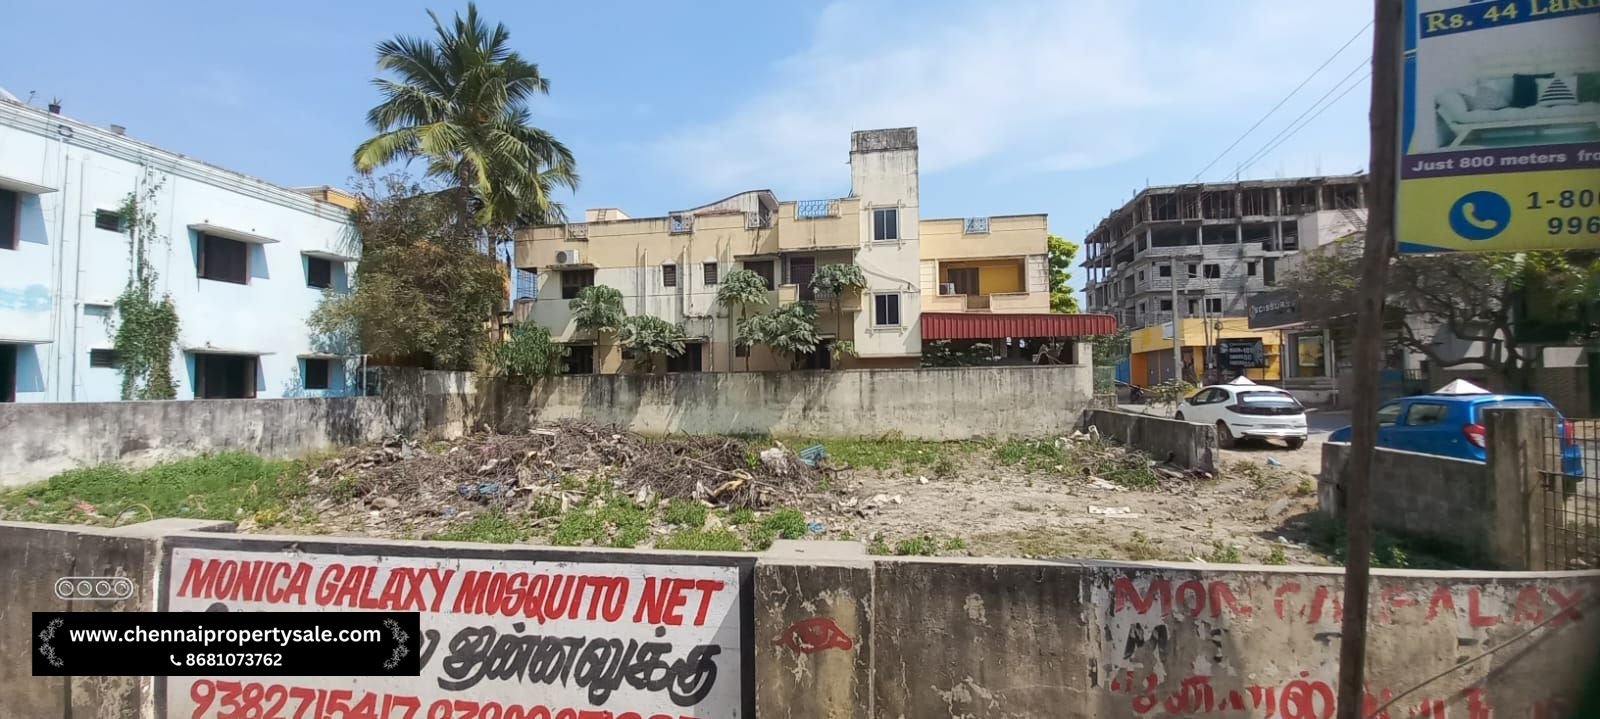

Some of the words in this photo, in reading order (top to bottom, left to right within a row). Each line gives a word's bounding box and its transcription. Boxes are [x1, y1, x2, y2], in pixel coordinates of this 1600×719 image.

[1425, 12, 1473, 33] Rs.
[1483, 3, 1518, 22] 44
[1412, 158, 1454, 172] Just
[1459, 155, 1495, 169] 800
[1500, 152, 1567, 166] meters
[1526, 189, 1600, 210] 1-80
[1547, 216, 1600, 235] 996
[176, 558, 314, 605] MONICA
[315, 563, 456, 613] GALAXY
[452, 569, 630, 626] MOSQUITO
[632, 576, 726, 626] NET
